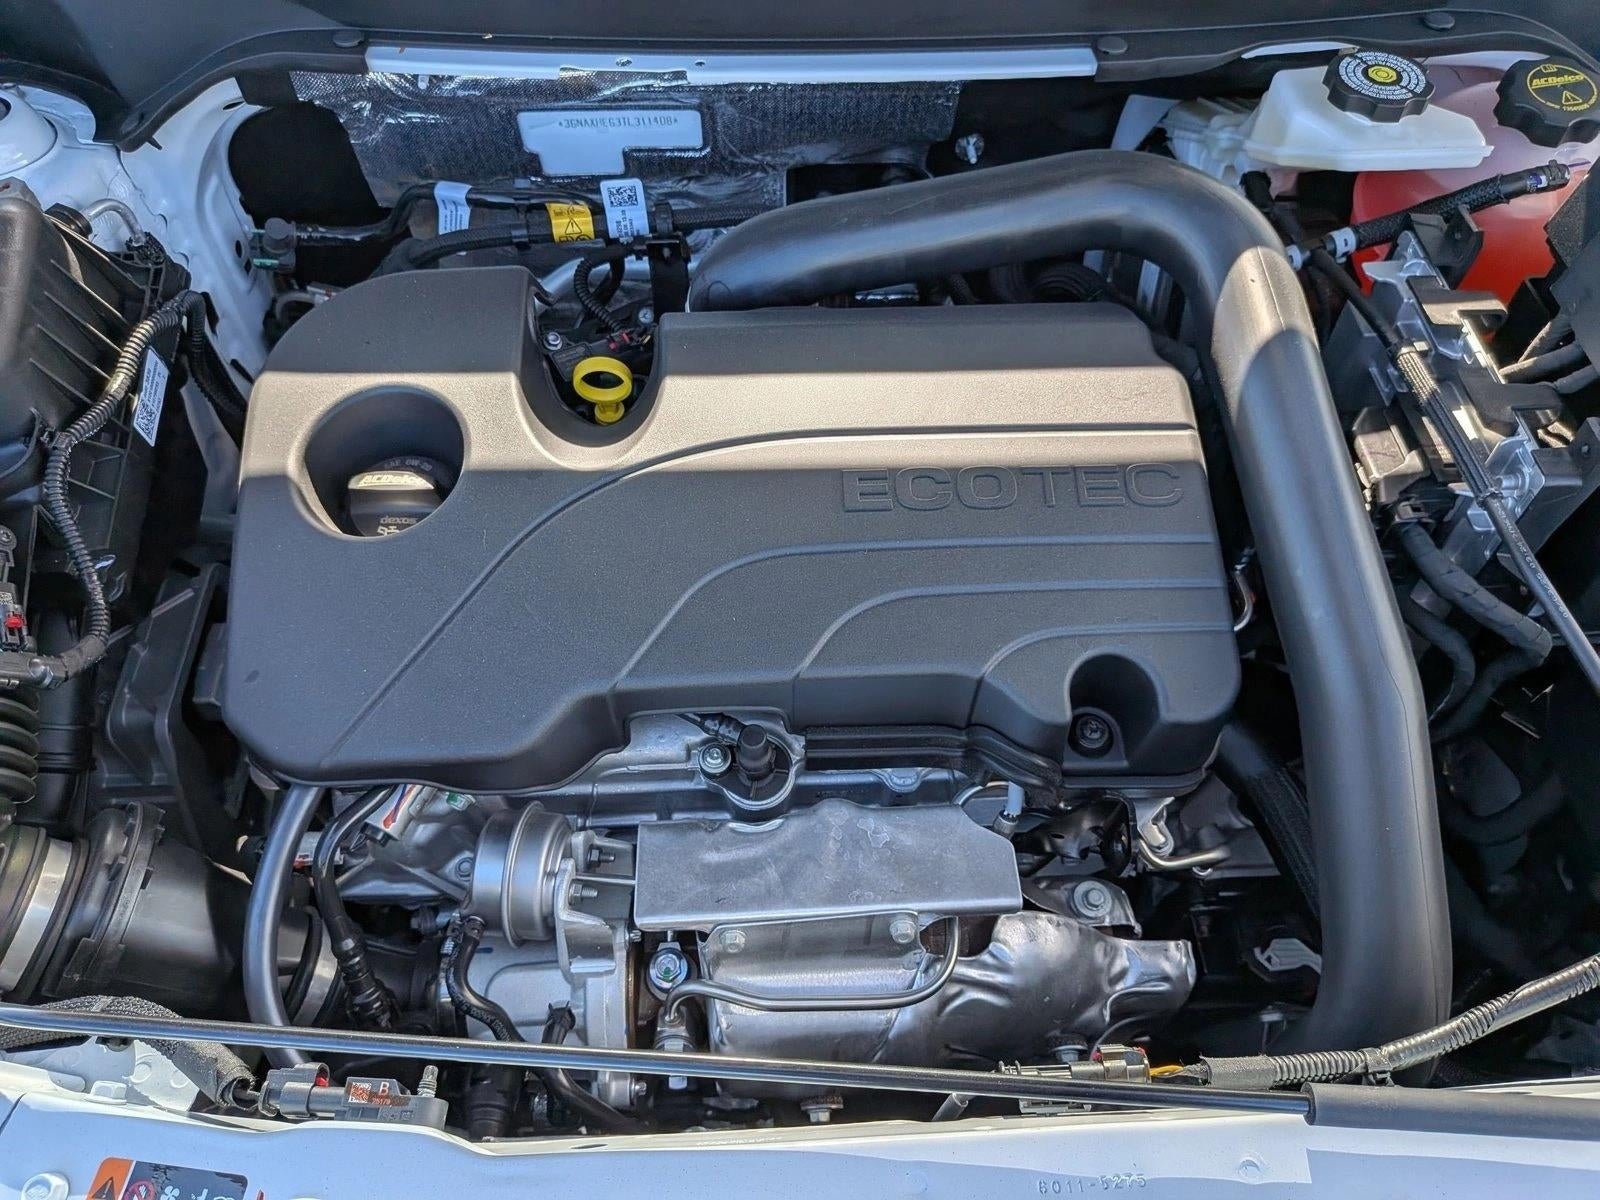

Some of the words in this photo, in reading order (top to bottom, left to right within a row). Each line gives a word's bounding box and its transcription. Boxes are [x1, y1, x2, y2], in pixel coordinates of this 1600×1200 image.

[1532, 74, 1585, 87] ACDelco
[842, 463, 1184, 513] ECOTEC
[380, 516, 417, 525] dexos
[379, 1081, 390, 1096] B
